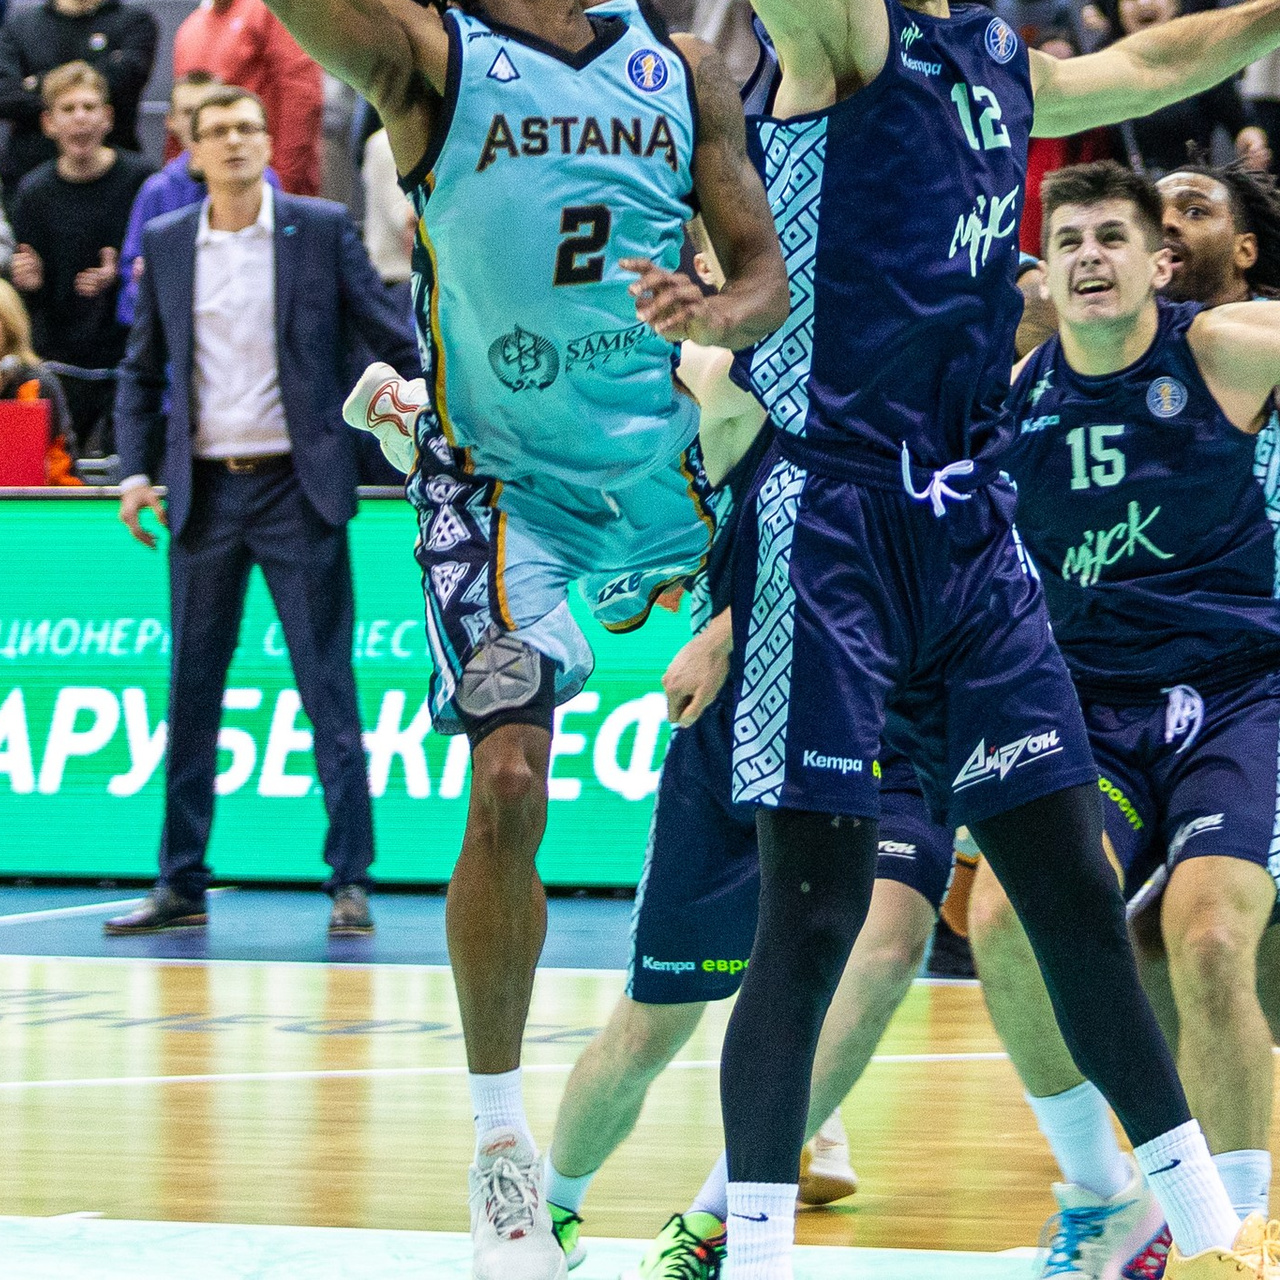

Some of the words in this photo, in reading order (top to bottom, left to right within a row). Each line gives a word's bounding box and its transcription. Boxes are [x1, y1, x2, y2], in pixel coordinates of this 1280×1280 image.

[900, 51, 943, 77] Kempa
[475, 112, 679, 172] ASTANA
[950, 82, 1012, 151] 12
[552, 203, 612, 288] 2
[1066, 424, 1126, 490] 15
[802, 749, 863, 774] Kempa
[642, 955, 696, 975] Kempa
